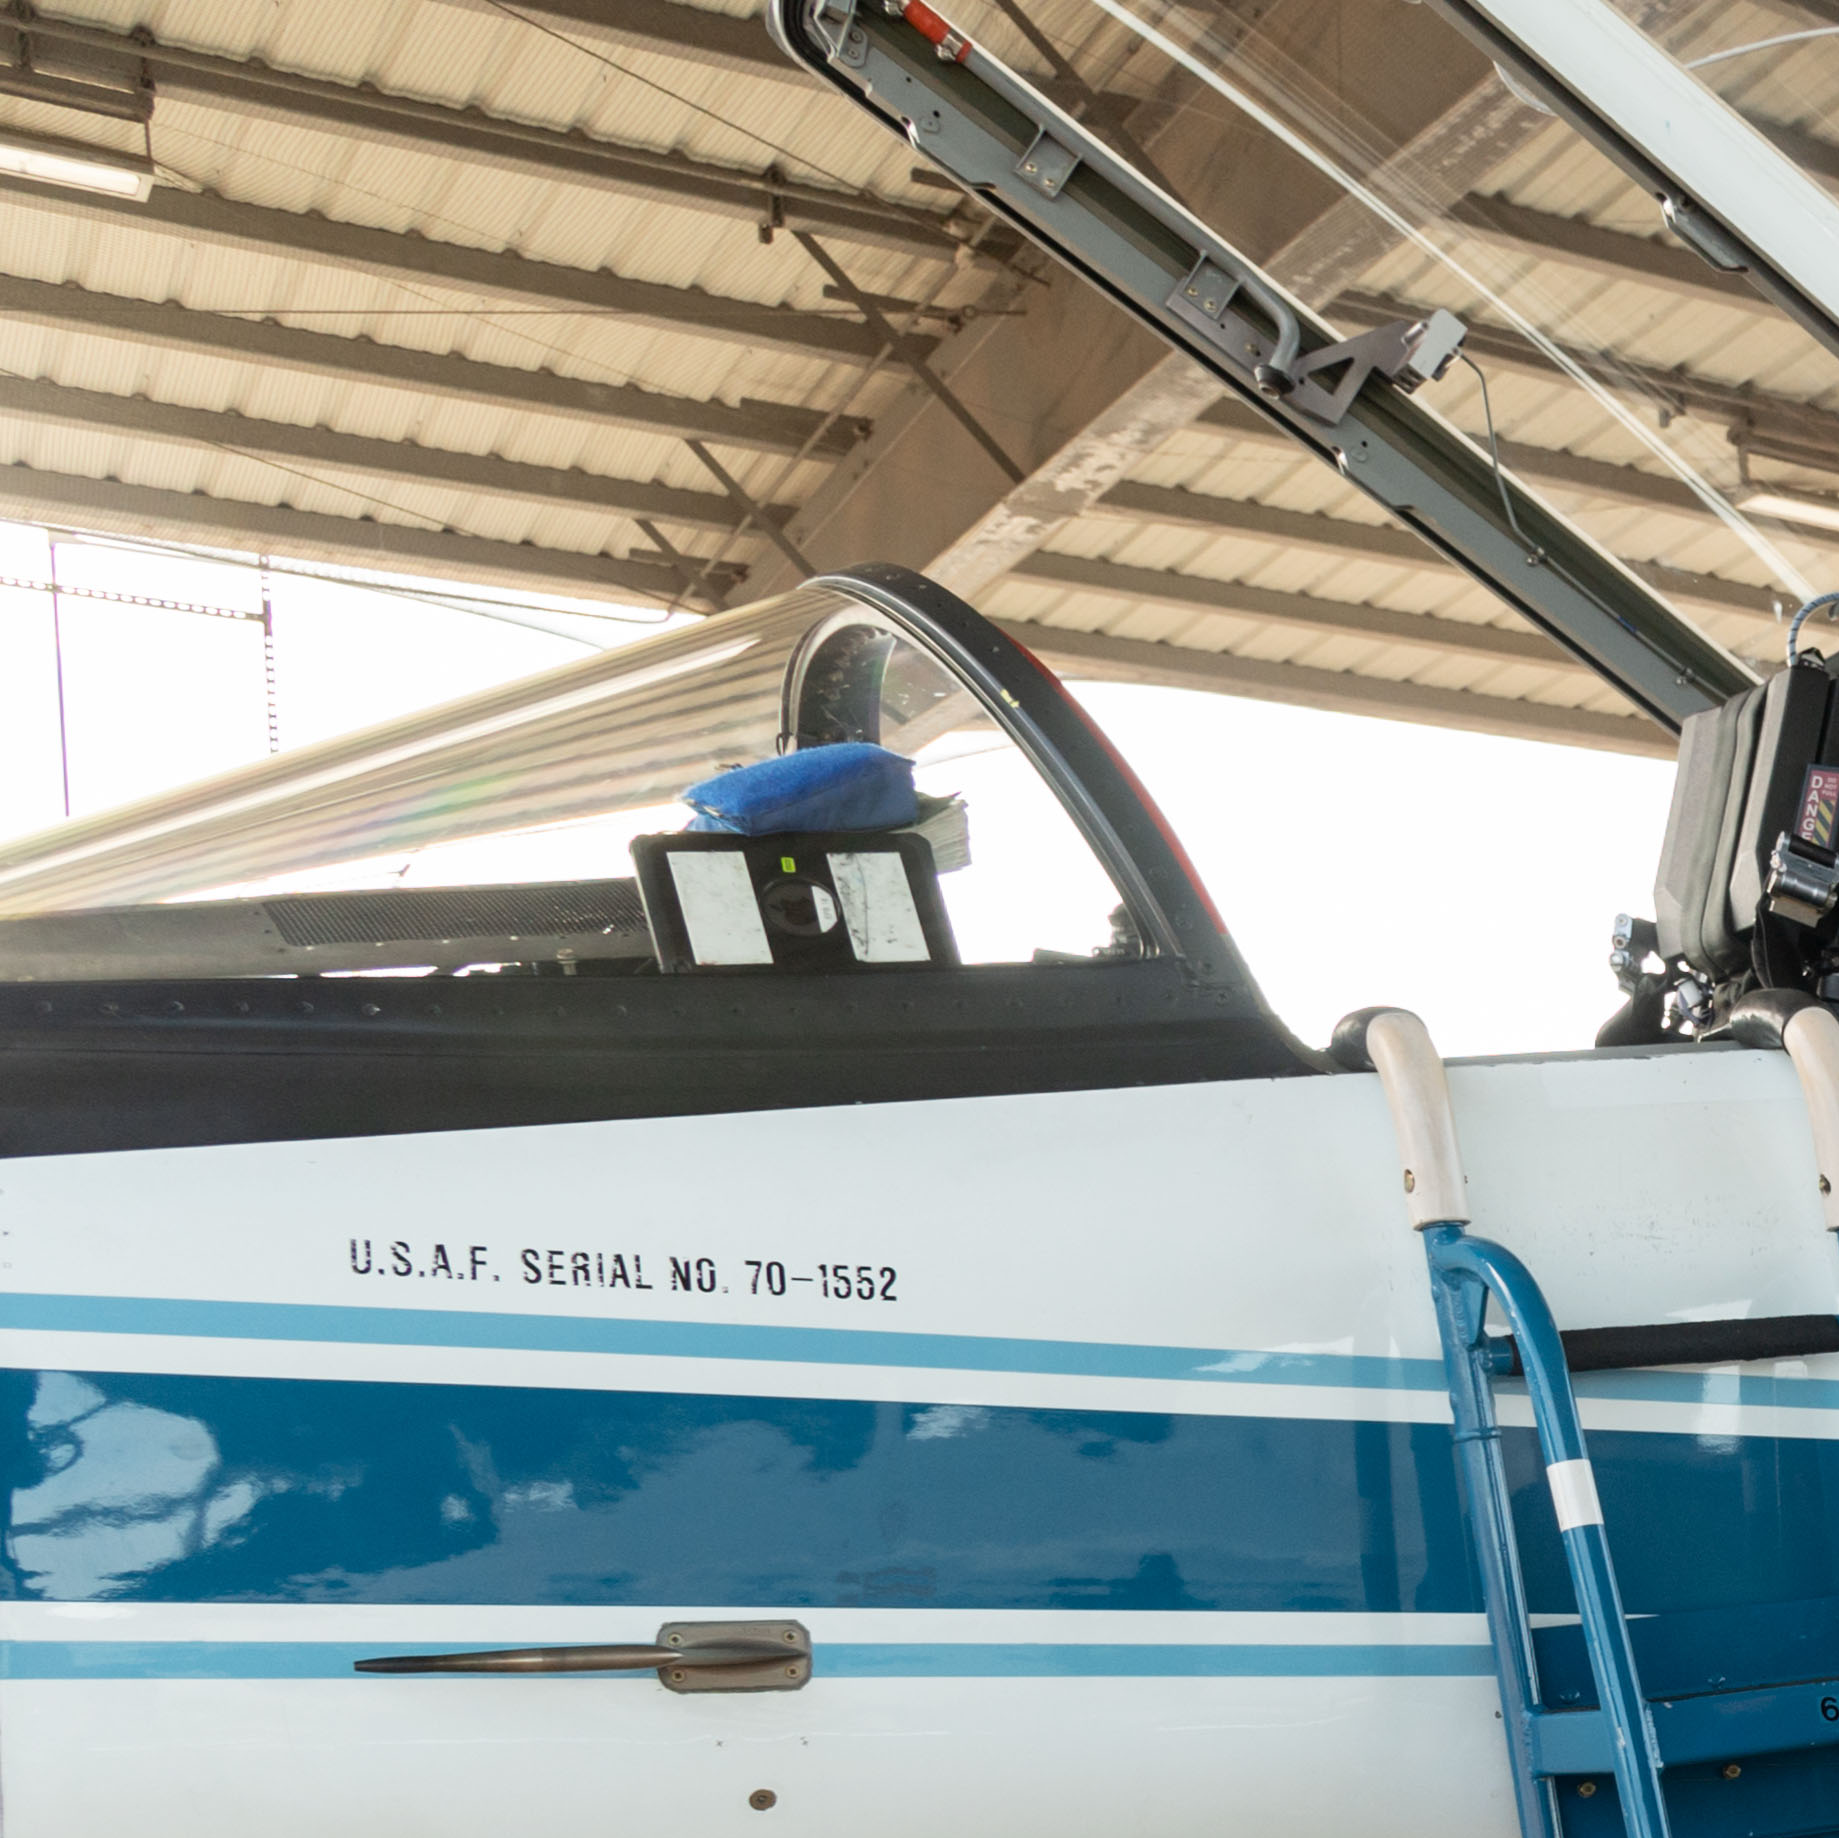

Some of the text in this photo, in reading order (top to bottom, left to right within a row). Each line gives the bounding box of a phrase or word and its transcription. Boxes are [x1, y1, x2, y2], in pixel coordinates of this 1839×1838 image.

[1801, 776, 1823, 840] DANGE
[349, 1239, 898, 1301] U.S.A.F. SERIAL NO. 70-1552
